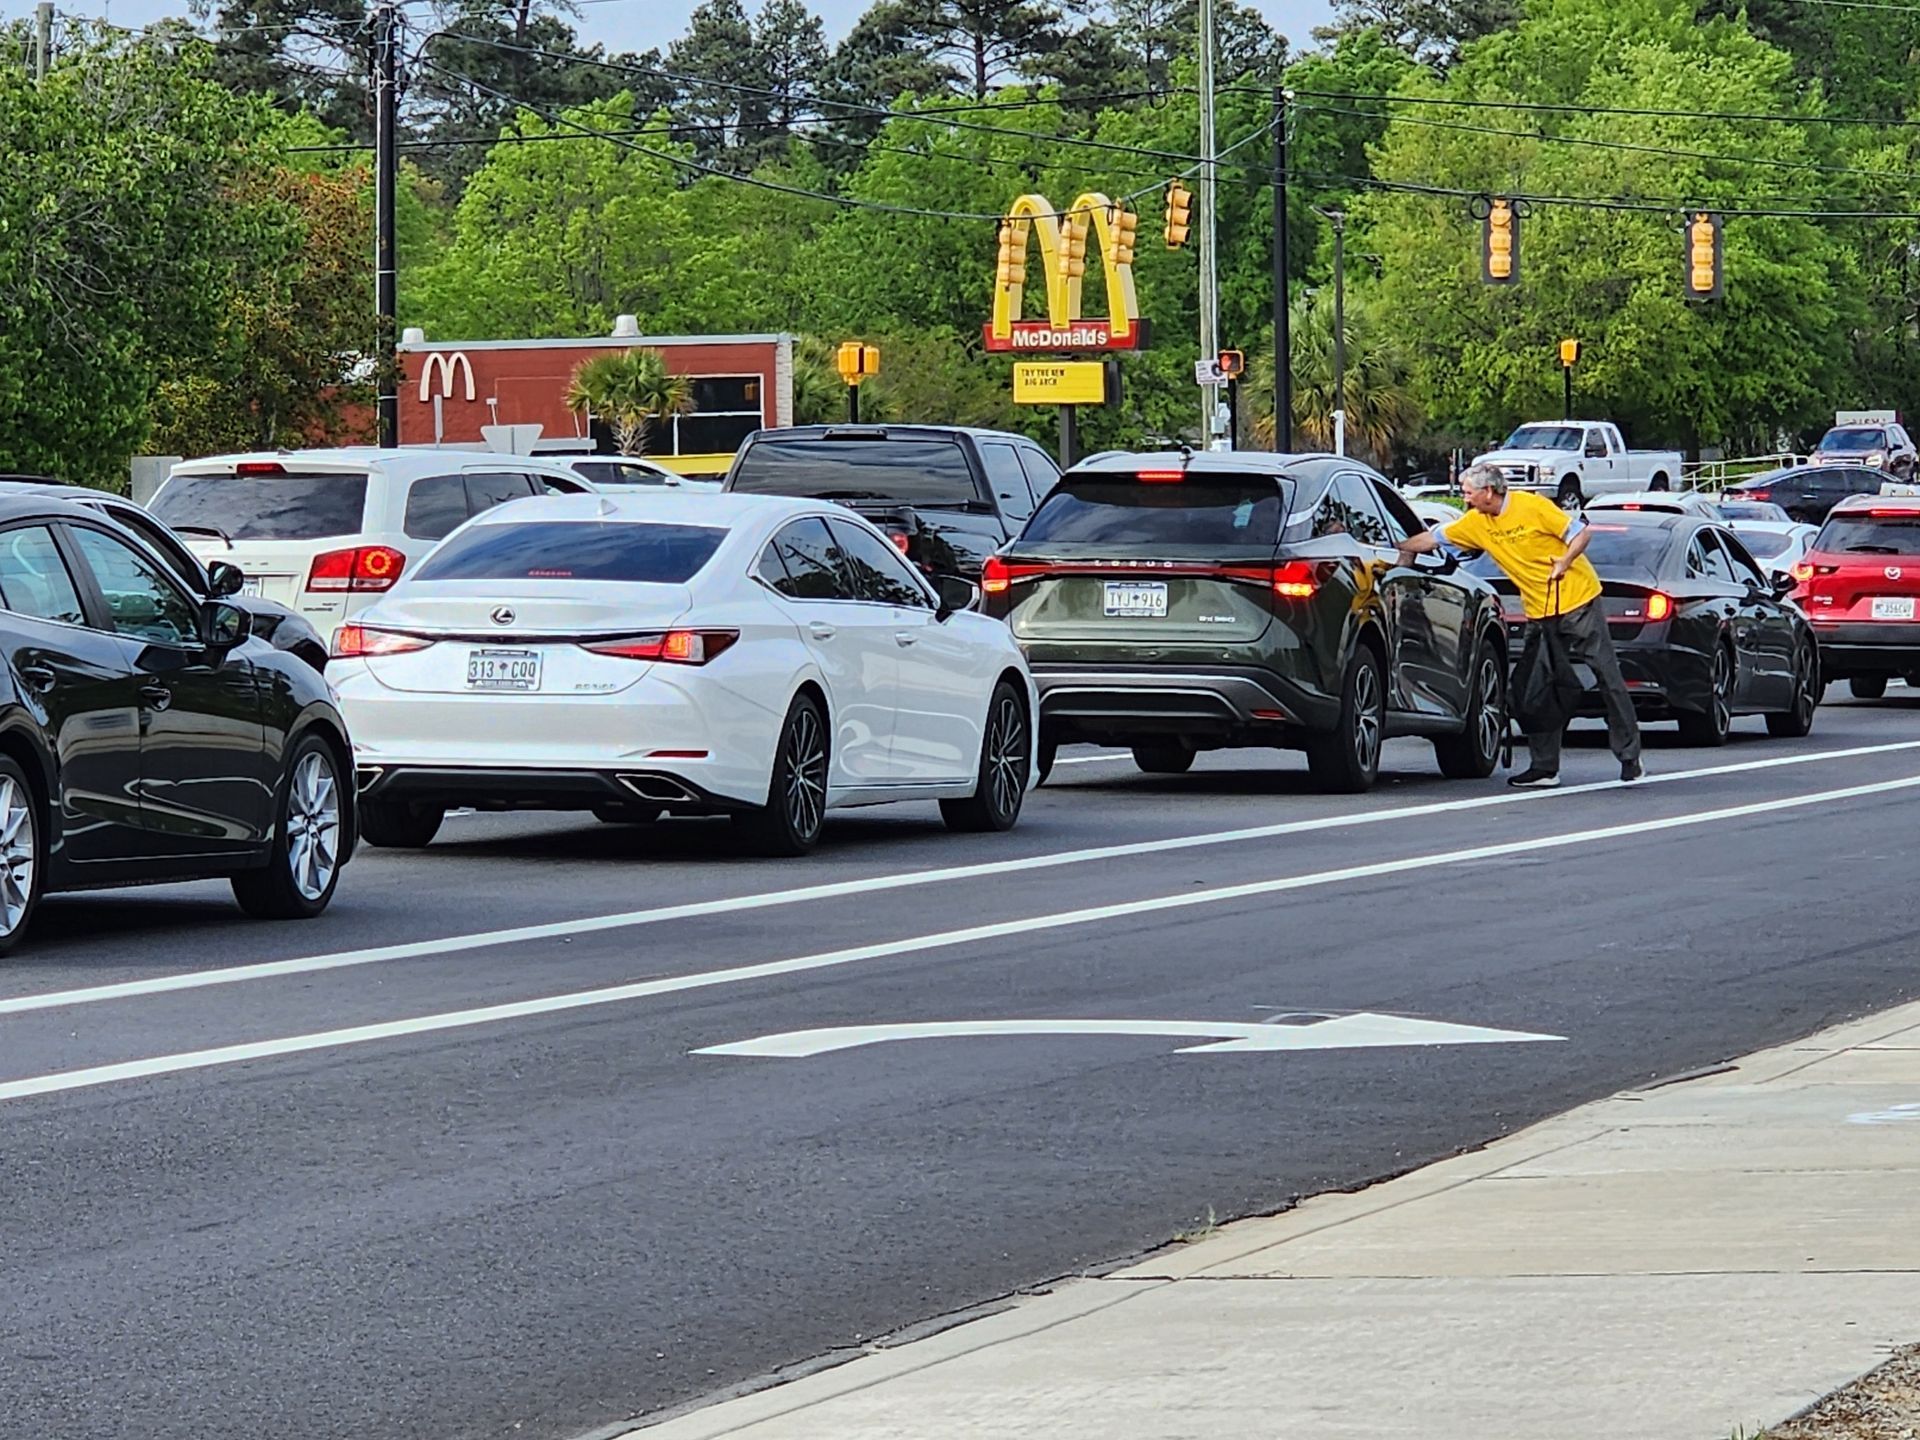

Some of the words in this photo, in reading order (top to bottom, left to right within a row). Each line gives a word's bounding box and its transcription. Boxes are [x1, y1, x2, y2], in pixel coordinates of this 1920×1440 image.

[1037, 369, 1049, 377] THE
[1039, 378, 1057, 386] ARCH
[1110, 592, 1131, 607] TYJ
[1141, 593, 1162, 607] 916
[470, 661, 494, 678] 313
